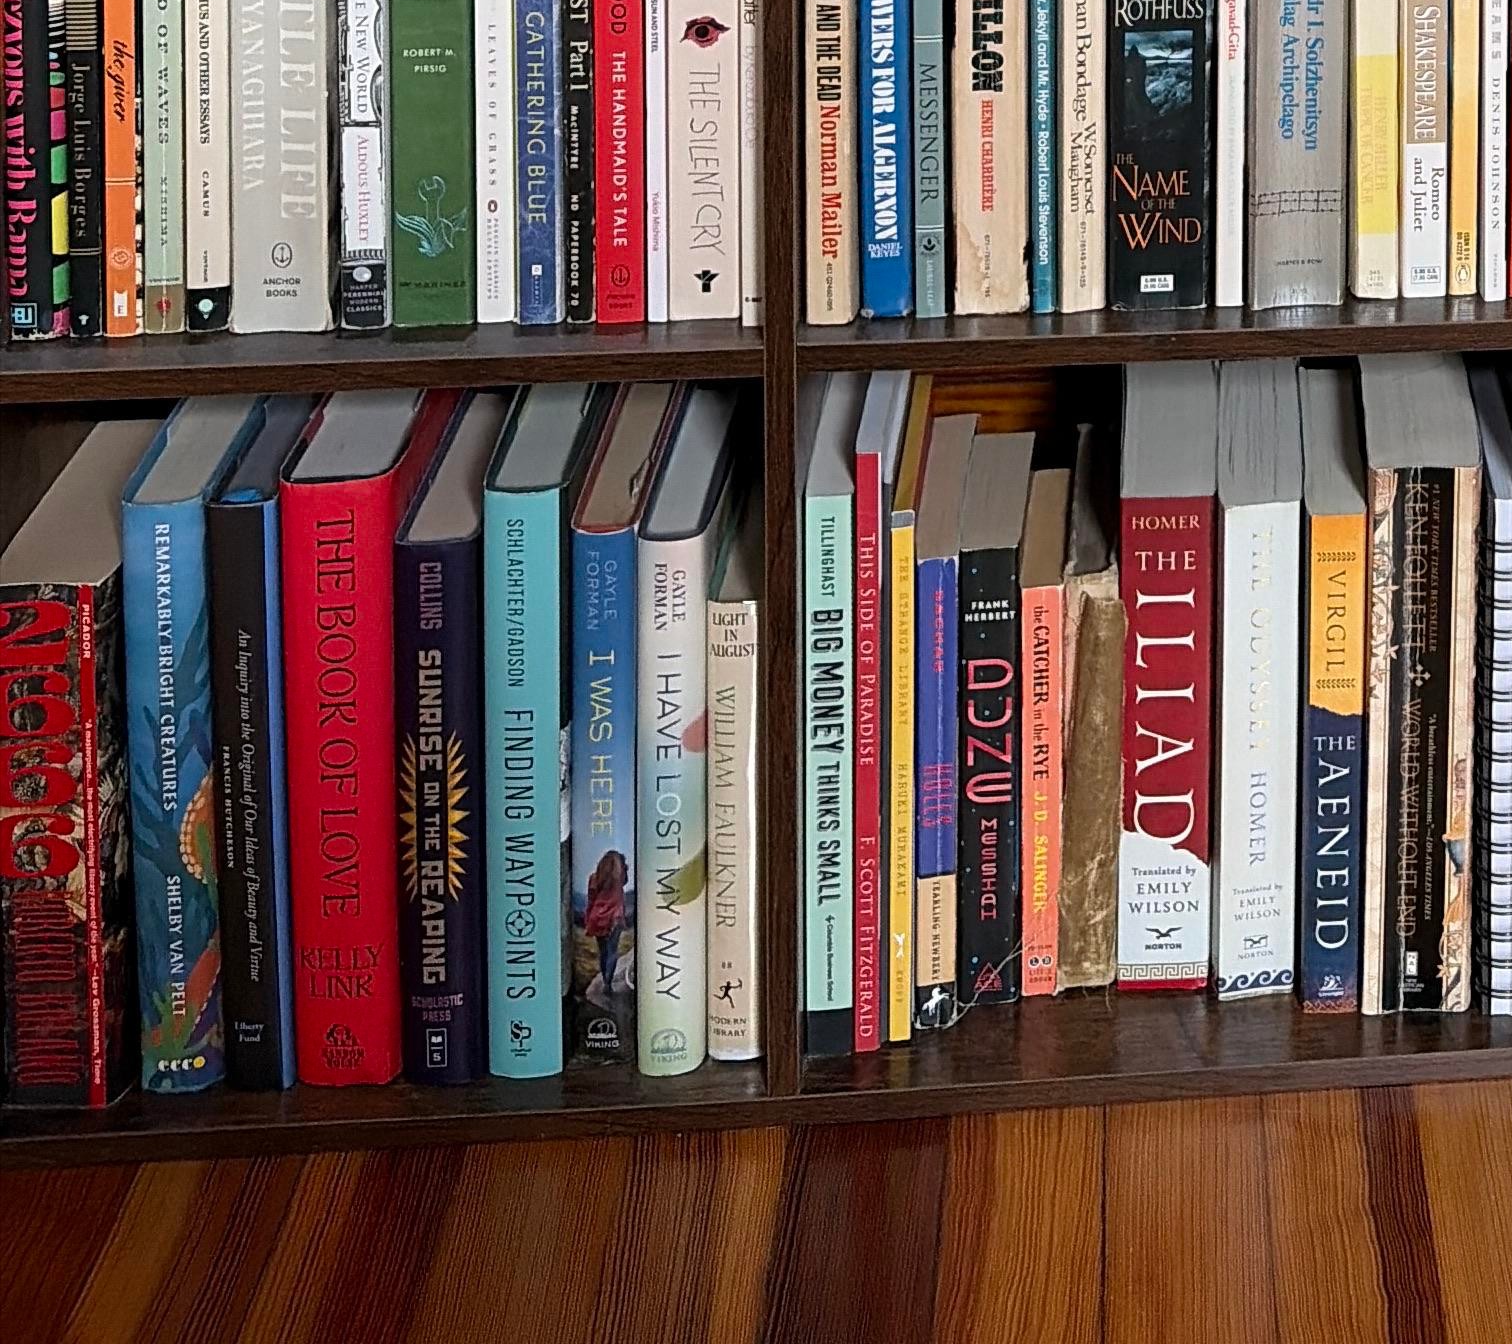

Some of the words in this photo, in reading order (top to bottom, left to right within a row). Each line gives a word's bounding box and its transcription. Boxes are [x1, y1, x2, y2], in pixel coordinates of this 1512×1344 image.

[403, 49, 442, 57] ROBERT
[414, 64, 447, 73] PIRSIG
[612, 51, 626, 84] THE
[525, 13, 546, 155] GATHERING
[280, 107, 317, 218] LIFE
[612, 90, 628, 201] HANDMAID'S
[1115, 153, 1135, 165] THE
[1414, 157, 1425, 185] and
[527, 166, 547, 224] BLUE
[1113, 164, 1191, 203] NAME
[1141, 199, 1154, 210] OF
[1155, 198, 1176, 209] THE
[1412, 188, 1425, 232] Juliet
[1431, 167, 1444, 221] Romeo
[613, 206, 628, 248] TALE
[1119, 213, 1203, 250] WIND
[1132, 513, 1201, 531] HOMER
[155, 523, 173, 640] REMARKABLY
[316, 510, 357, 595] THE
[1135, 549, 1197, 572] THE
[810, 608, 844, 655] BIG
[1326, 570, 1347, 672] VIRGIL
[158, 644, 174, 709] BRIGHT
[316, 605, 358, 728] BOOK
[810, 661, 845, 754] MONEY
[1135, 588, 1197, 852] ILIAD
[0, 600, 80, 878] 2666
[159, 714, 178, 812] CREATURES
[319, 739, 358, 797] OF
[1313, 735, 1356, 751] THE
[816, 762, 841, 832] THINKS
[320, 808, 361, 919] LOVE
[816, 840, 841, 906] SMALL
[860, 837, 875, 856] F.
[1315, 760, 1350, 950] AENEID
[859, 859, 875, 920] SCOTT
[859, 925, 876, 1038] FITZGERALD
